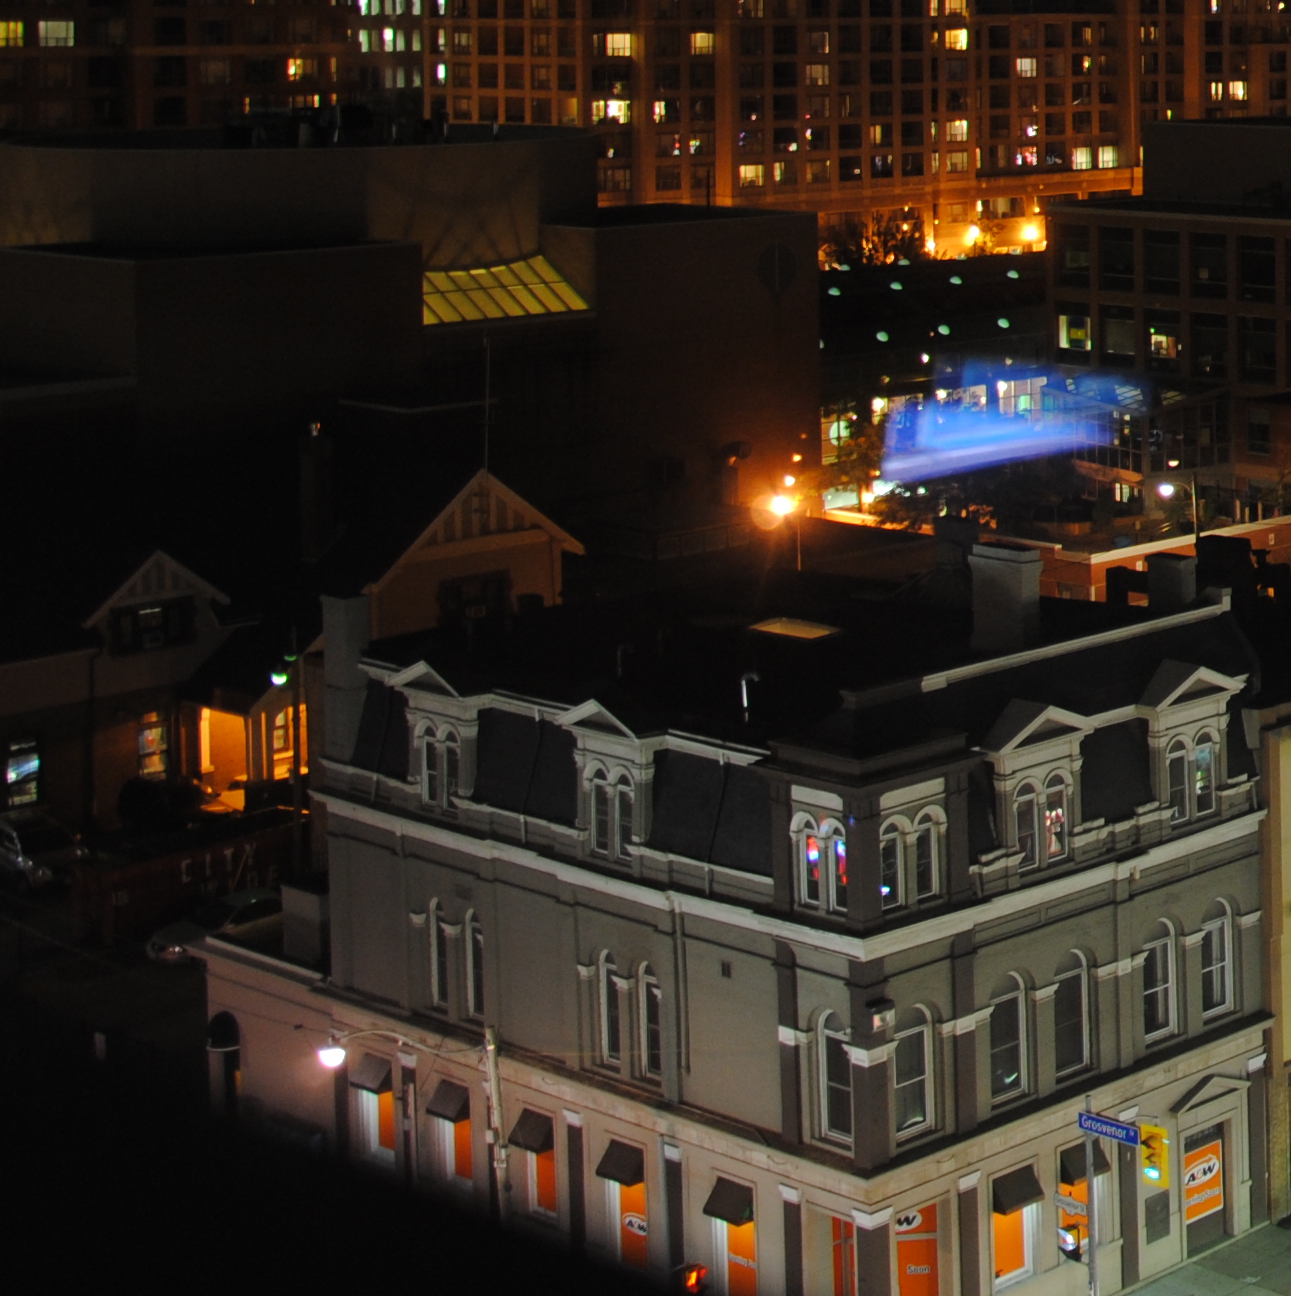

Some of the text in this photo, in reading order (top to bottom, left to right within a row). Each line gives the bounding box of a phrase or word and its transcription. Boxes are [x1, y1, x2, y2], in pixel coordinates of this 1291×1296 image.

[1081, 1115, 1127, 1139] Grosvenor
[1185, 1161, 1217, 1187] A&W
[906, 1264, 931, 1275] Soon
